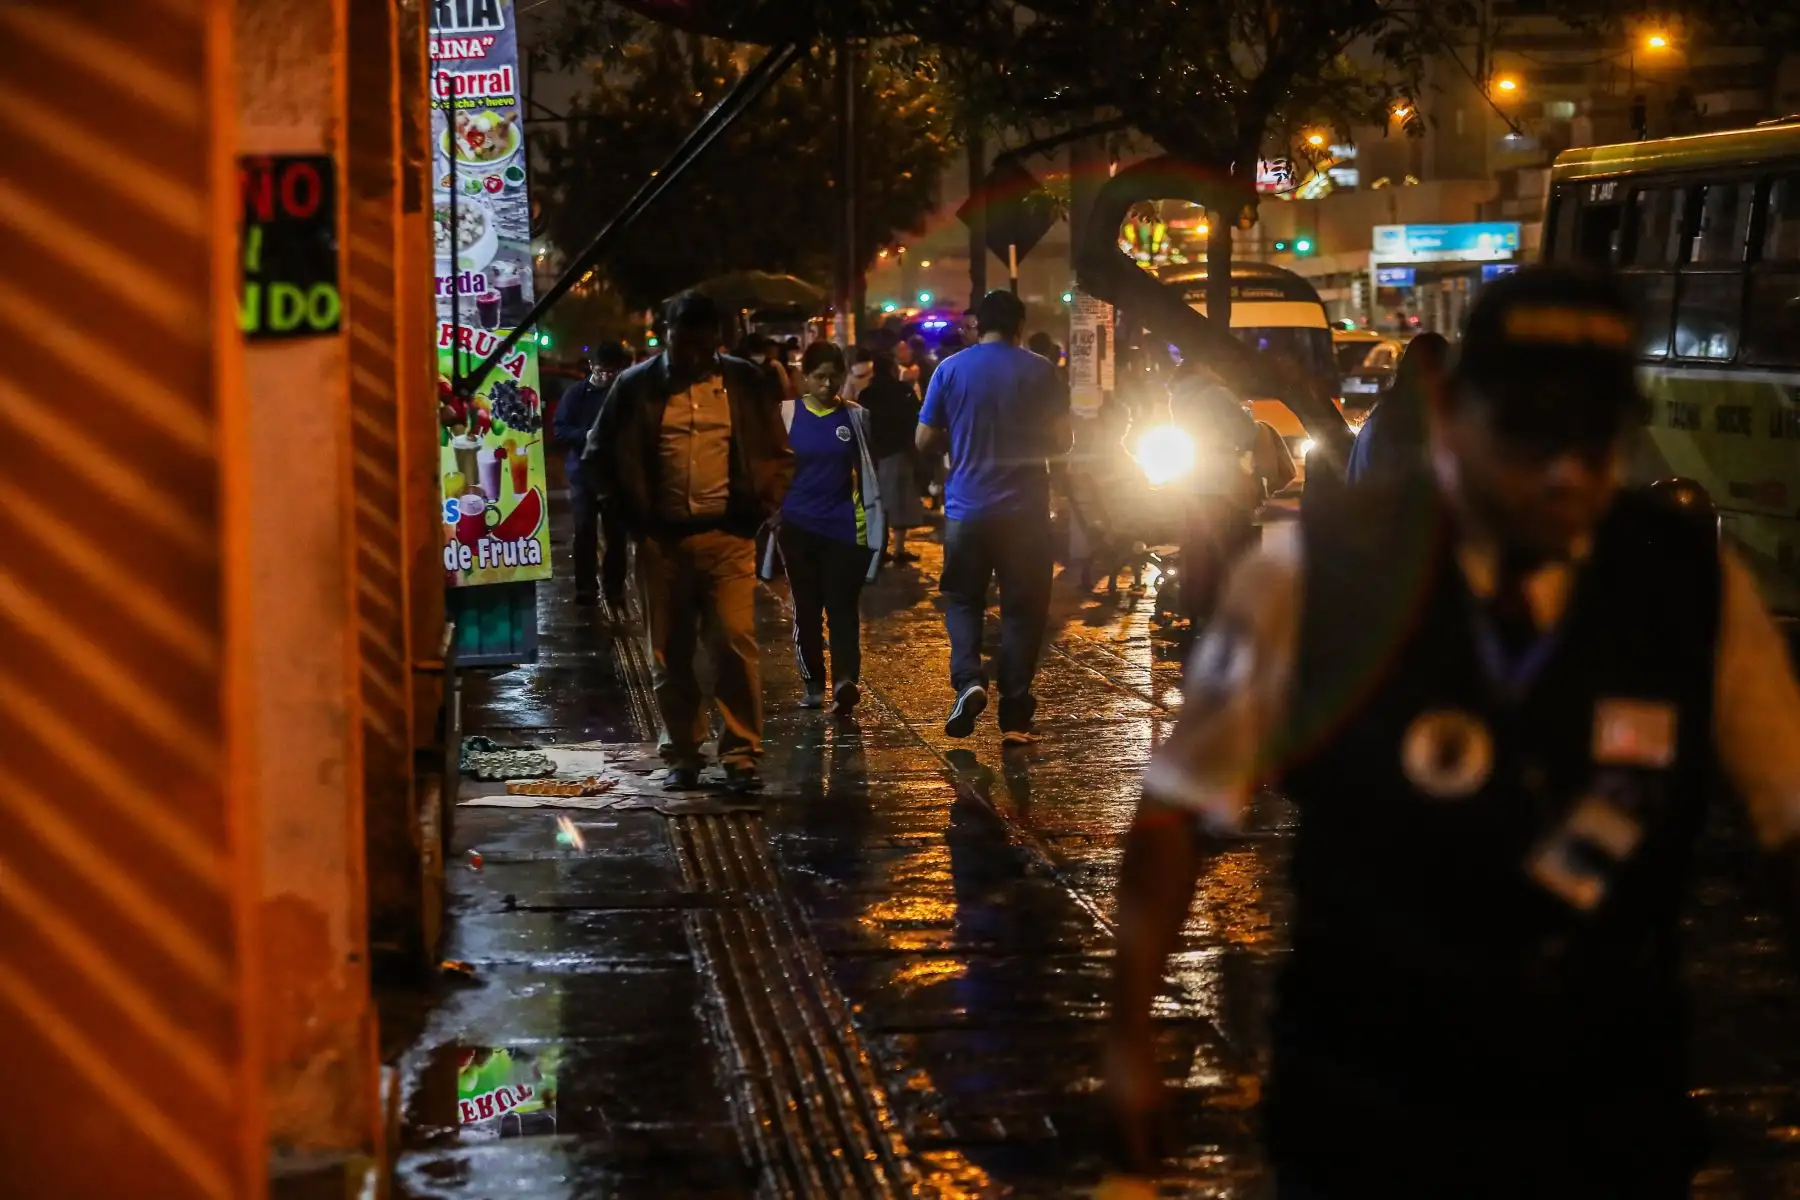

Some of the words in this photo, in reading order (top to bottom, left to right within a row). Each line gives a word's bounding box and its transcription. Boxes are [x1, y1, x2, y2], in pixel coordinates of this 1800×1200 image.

[435, 68, 511, 96] Corral
[486, 96, 515, 107] huevo
[438, 322, 527, 379] FRUA
[443, 539, 472, 570] de
[477, 537, 542, 569] Fruta
